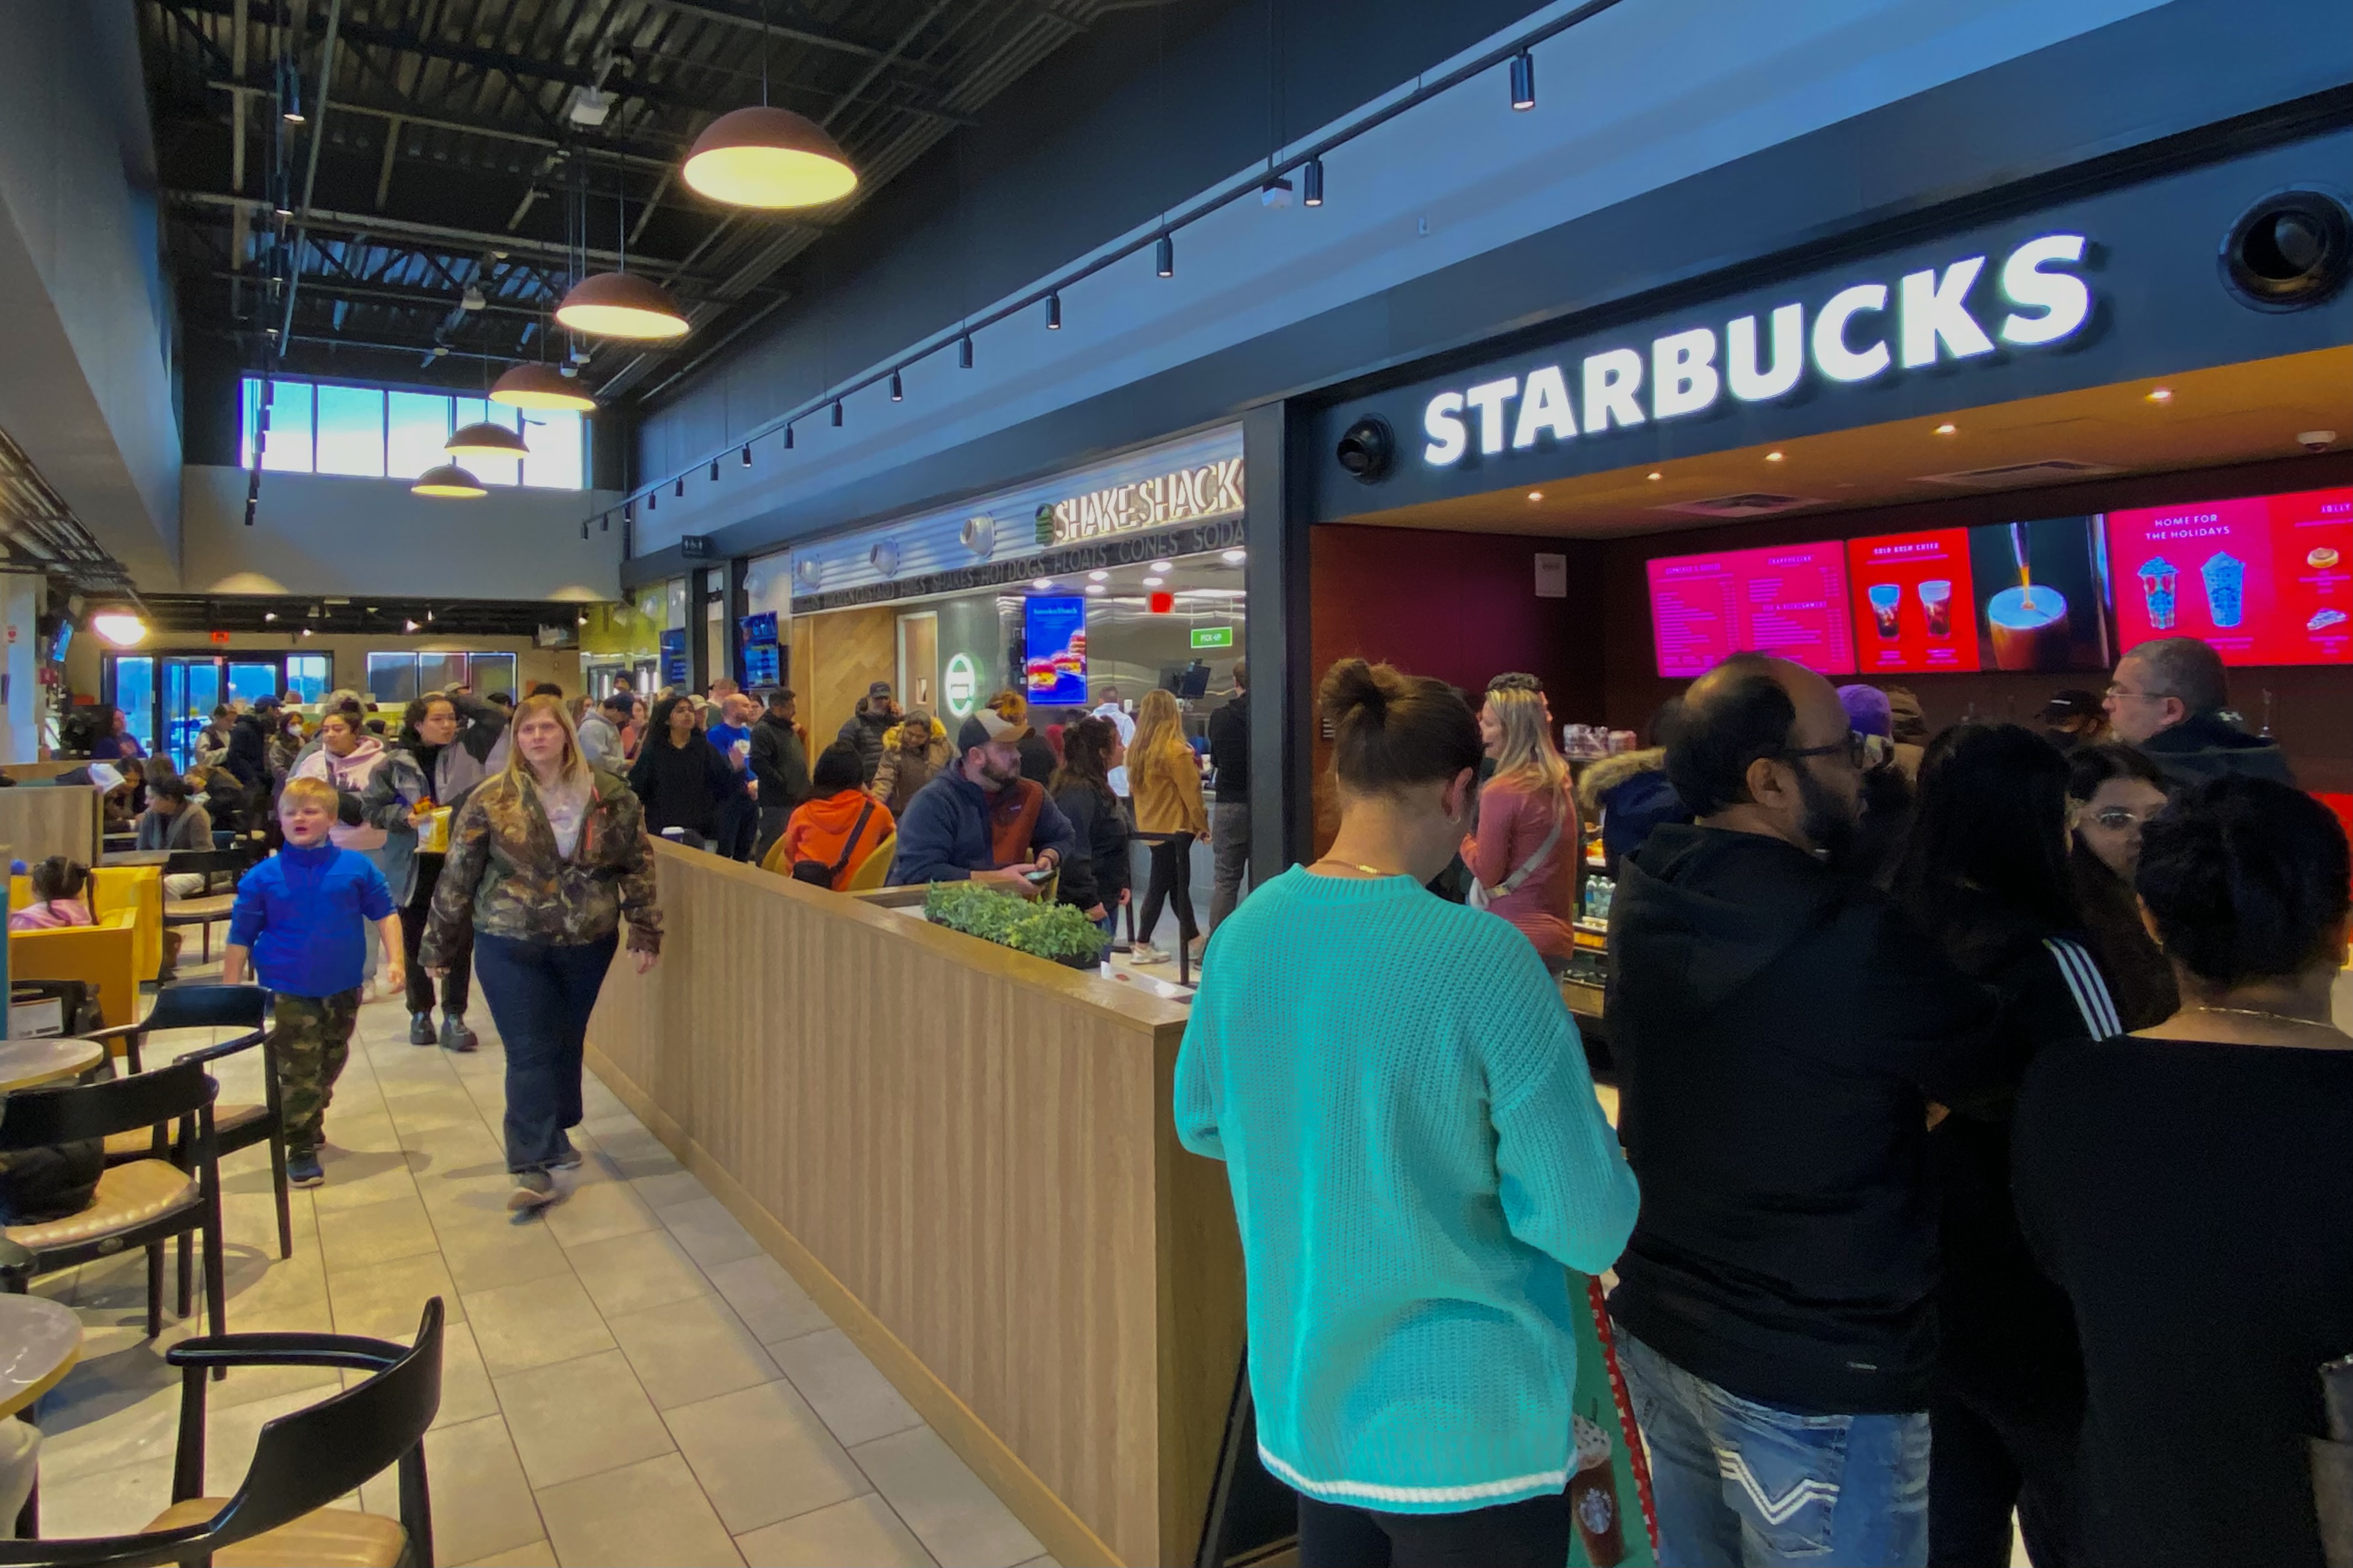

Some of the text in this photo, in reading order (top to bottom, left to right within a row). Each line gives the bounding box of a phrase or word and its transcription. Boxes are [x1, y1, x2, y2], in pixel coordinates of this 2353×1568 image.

[1424, 234, 2089, 466] STARBUCKS
[1055, 458, 1244, 541] SHAKE SHACK
[2155, 514, 2218, 527] HOME FOR
[2171, 526, 2230, 538] HOLIDAYS
[932, 568, 974, 591] SHAKES
[981, 563, 1006, 585] HOT
[1008, 558, 1045, 579] DOGS
[1054, 546, 1107, 573] FLOATS
[1119, 535, 1178, 562] CONES
[1193, 521, 1244, 552] SODA
